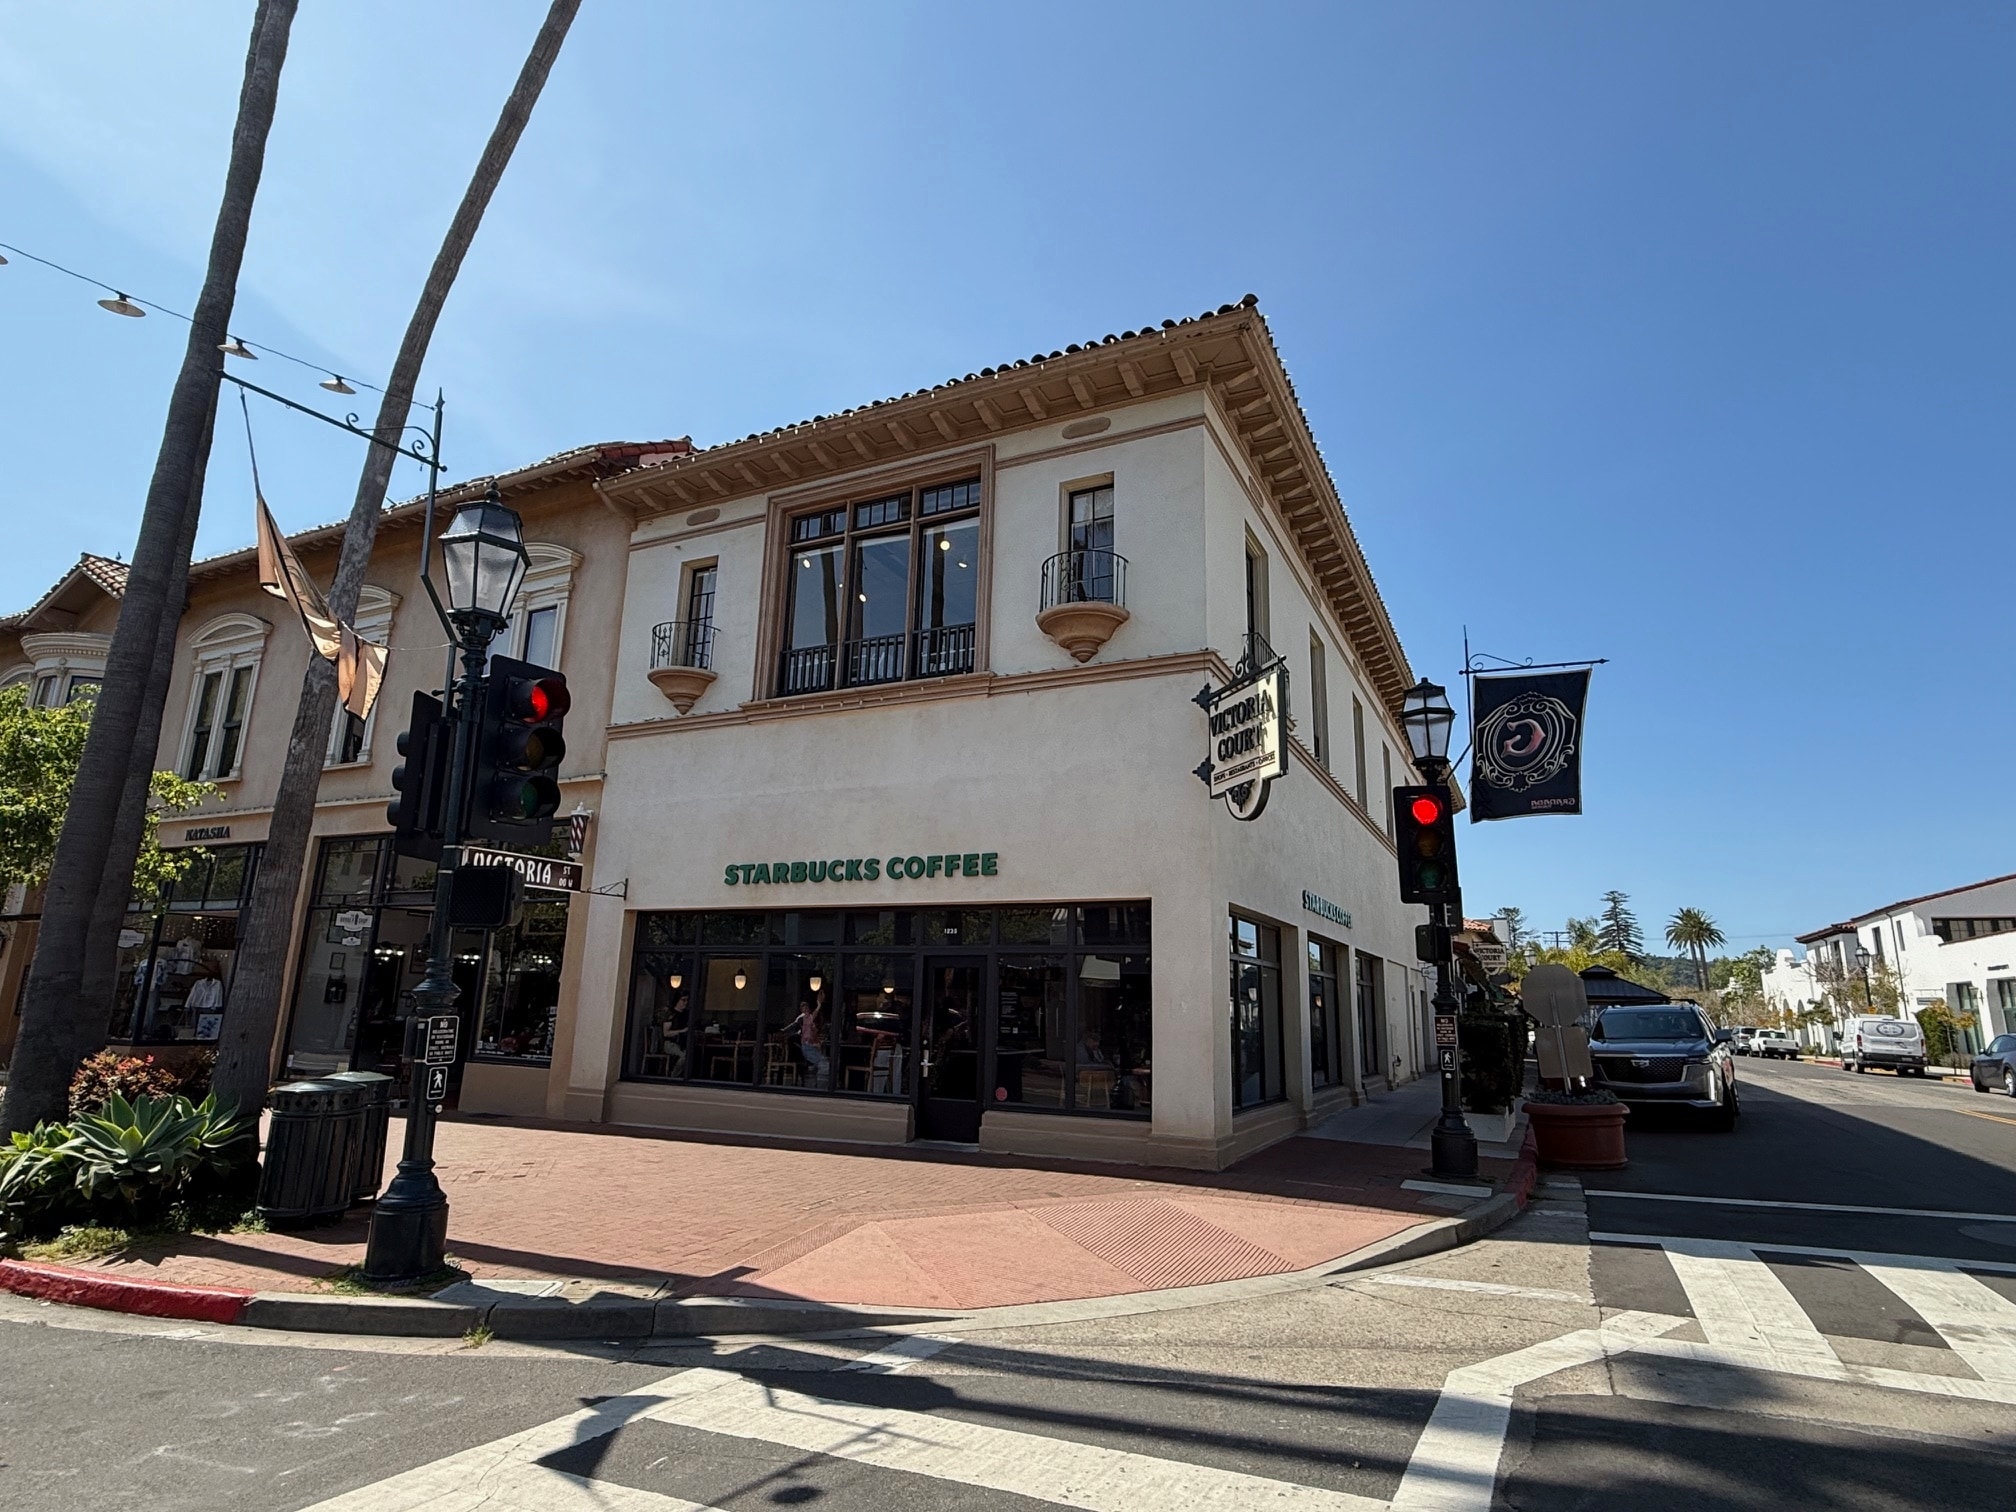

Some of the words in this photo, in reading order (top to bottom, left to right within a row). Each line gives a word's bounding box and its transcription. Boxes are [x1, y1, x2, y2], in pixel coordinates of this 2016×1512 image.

[1211, 689, 1272, 737] VICTORIA
[1217, 721, 1263, 762] COURT
[185, 826, 230, 841] NATASHA
[563, 866, 571, 875] ST
[724, 857, 880, 886] STARBUCKS
[886, 852, 998, 879] COFFEE
[1302, 889, 1335, 922] STARBUCKS
